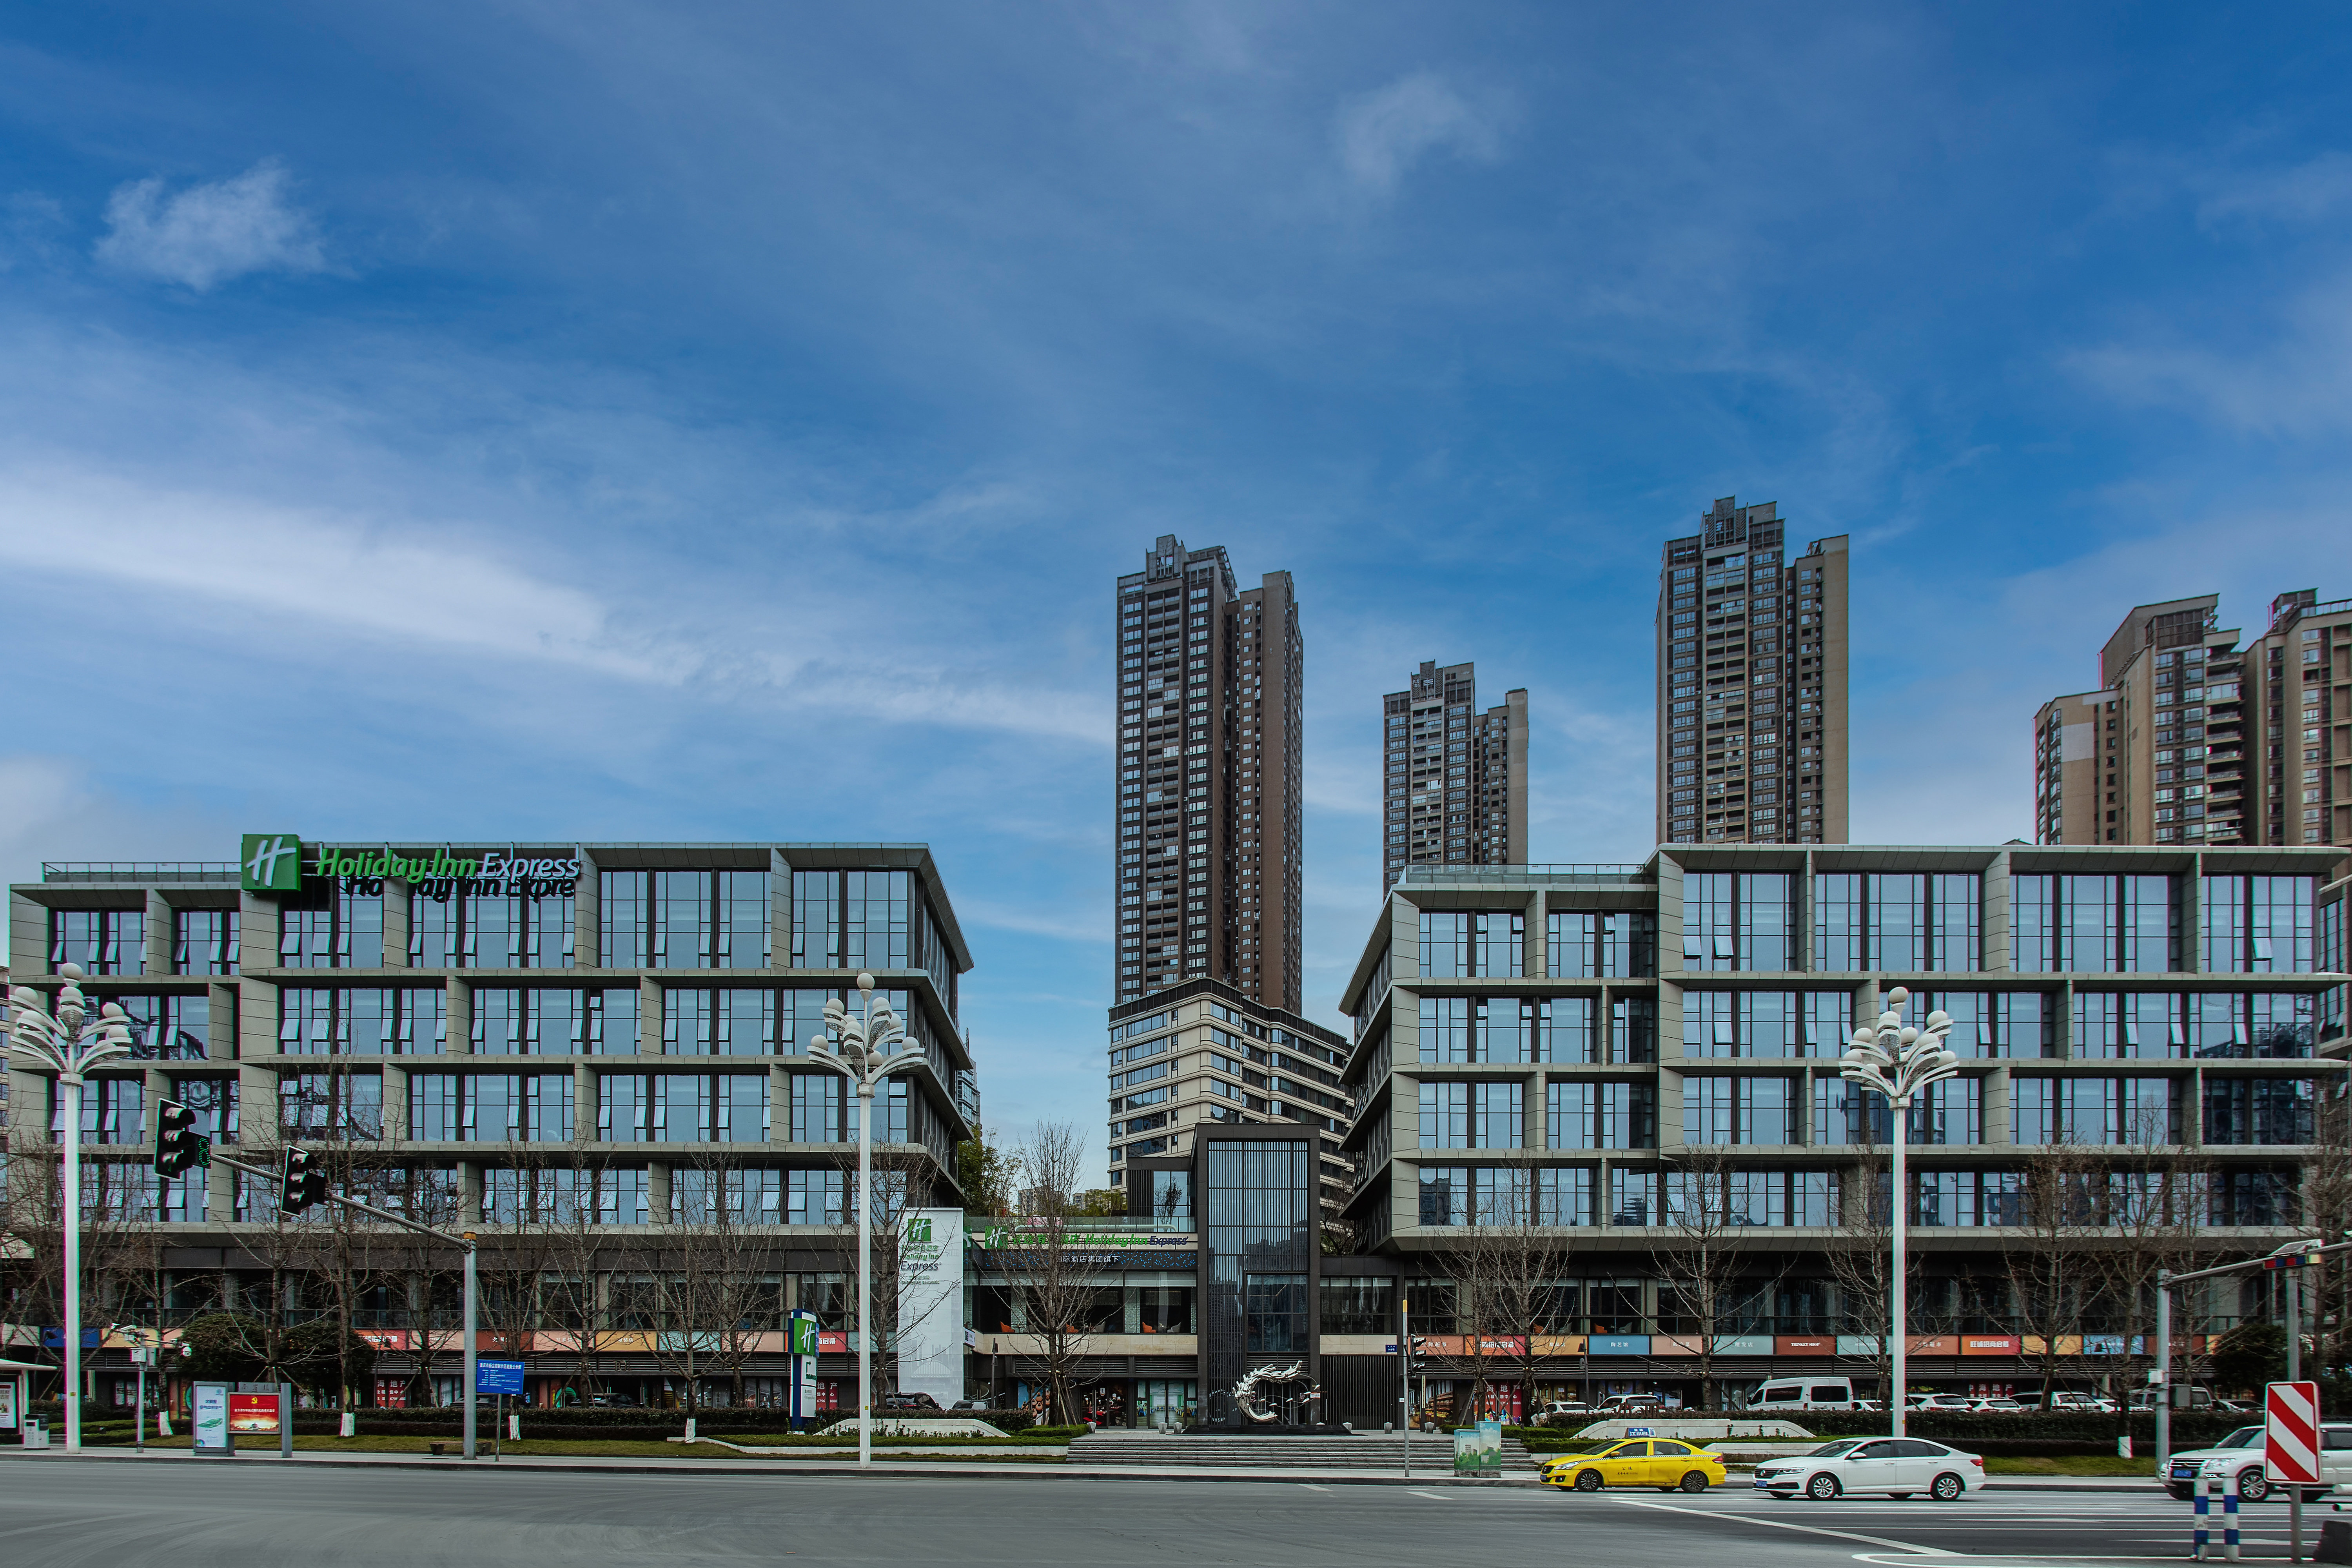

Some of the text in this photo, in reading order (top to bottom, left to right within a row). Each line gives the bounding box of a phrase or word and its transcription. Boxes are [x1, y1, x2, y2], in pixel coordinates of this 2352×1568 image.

[316, 848, 580, 884] Holiday Inn Express
[1012, 1234, 1187, 1247] 智选假酒店 Holiday Inn Express
[904, 1252, 927, 1261] oliday
[901, 1261, 938, 1272] Express
